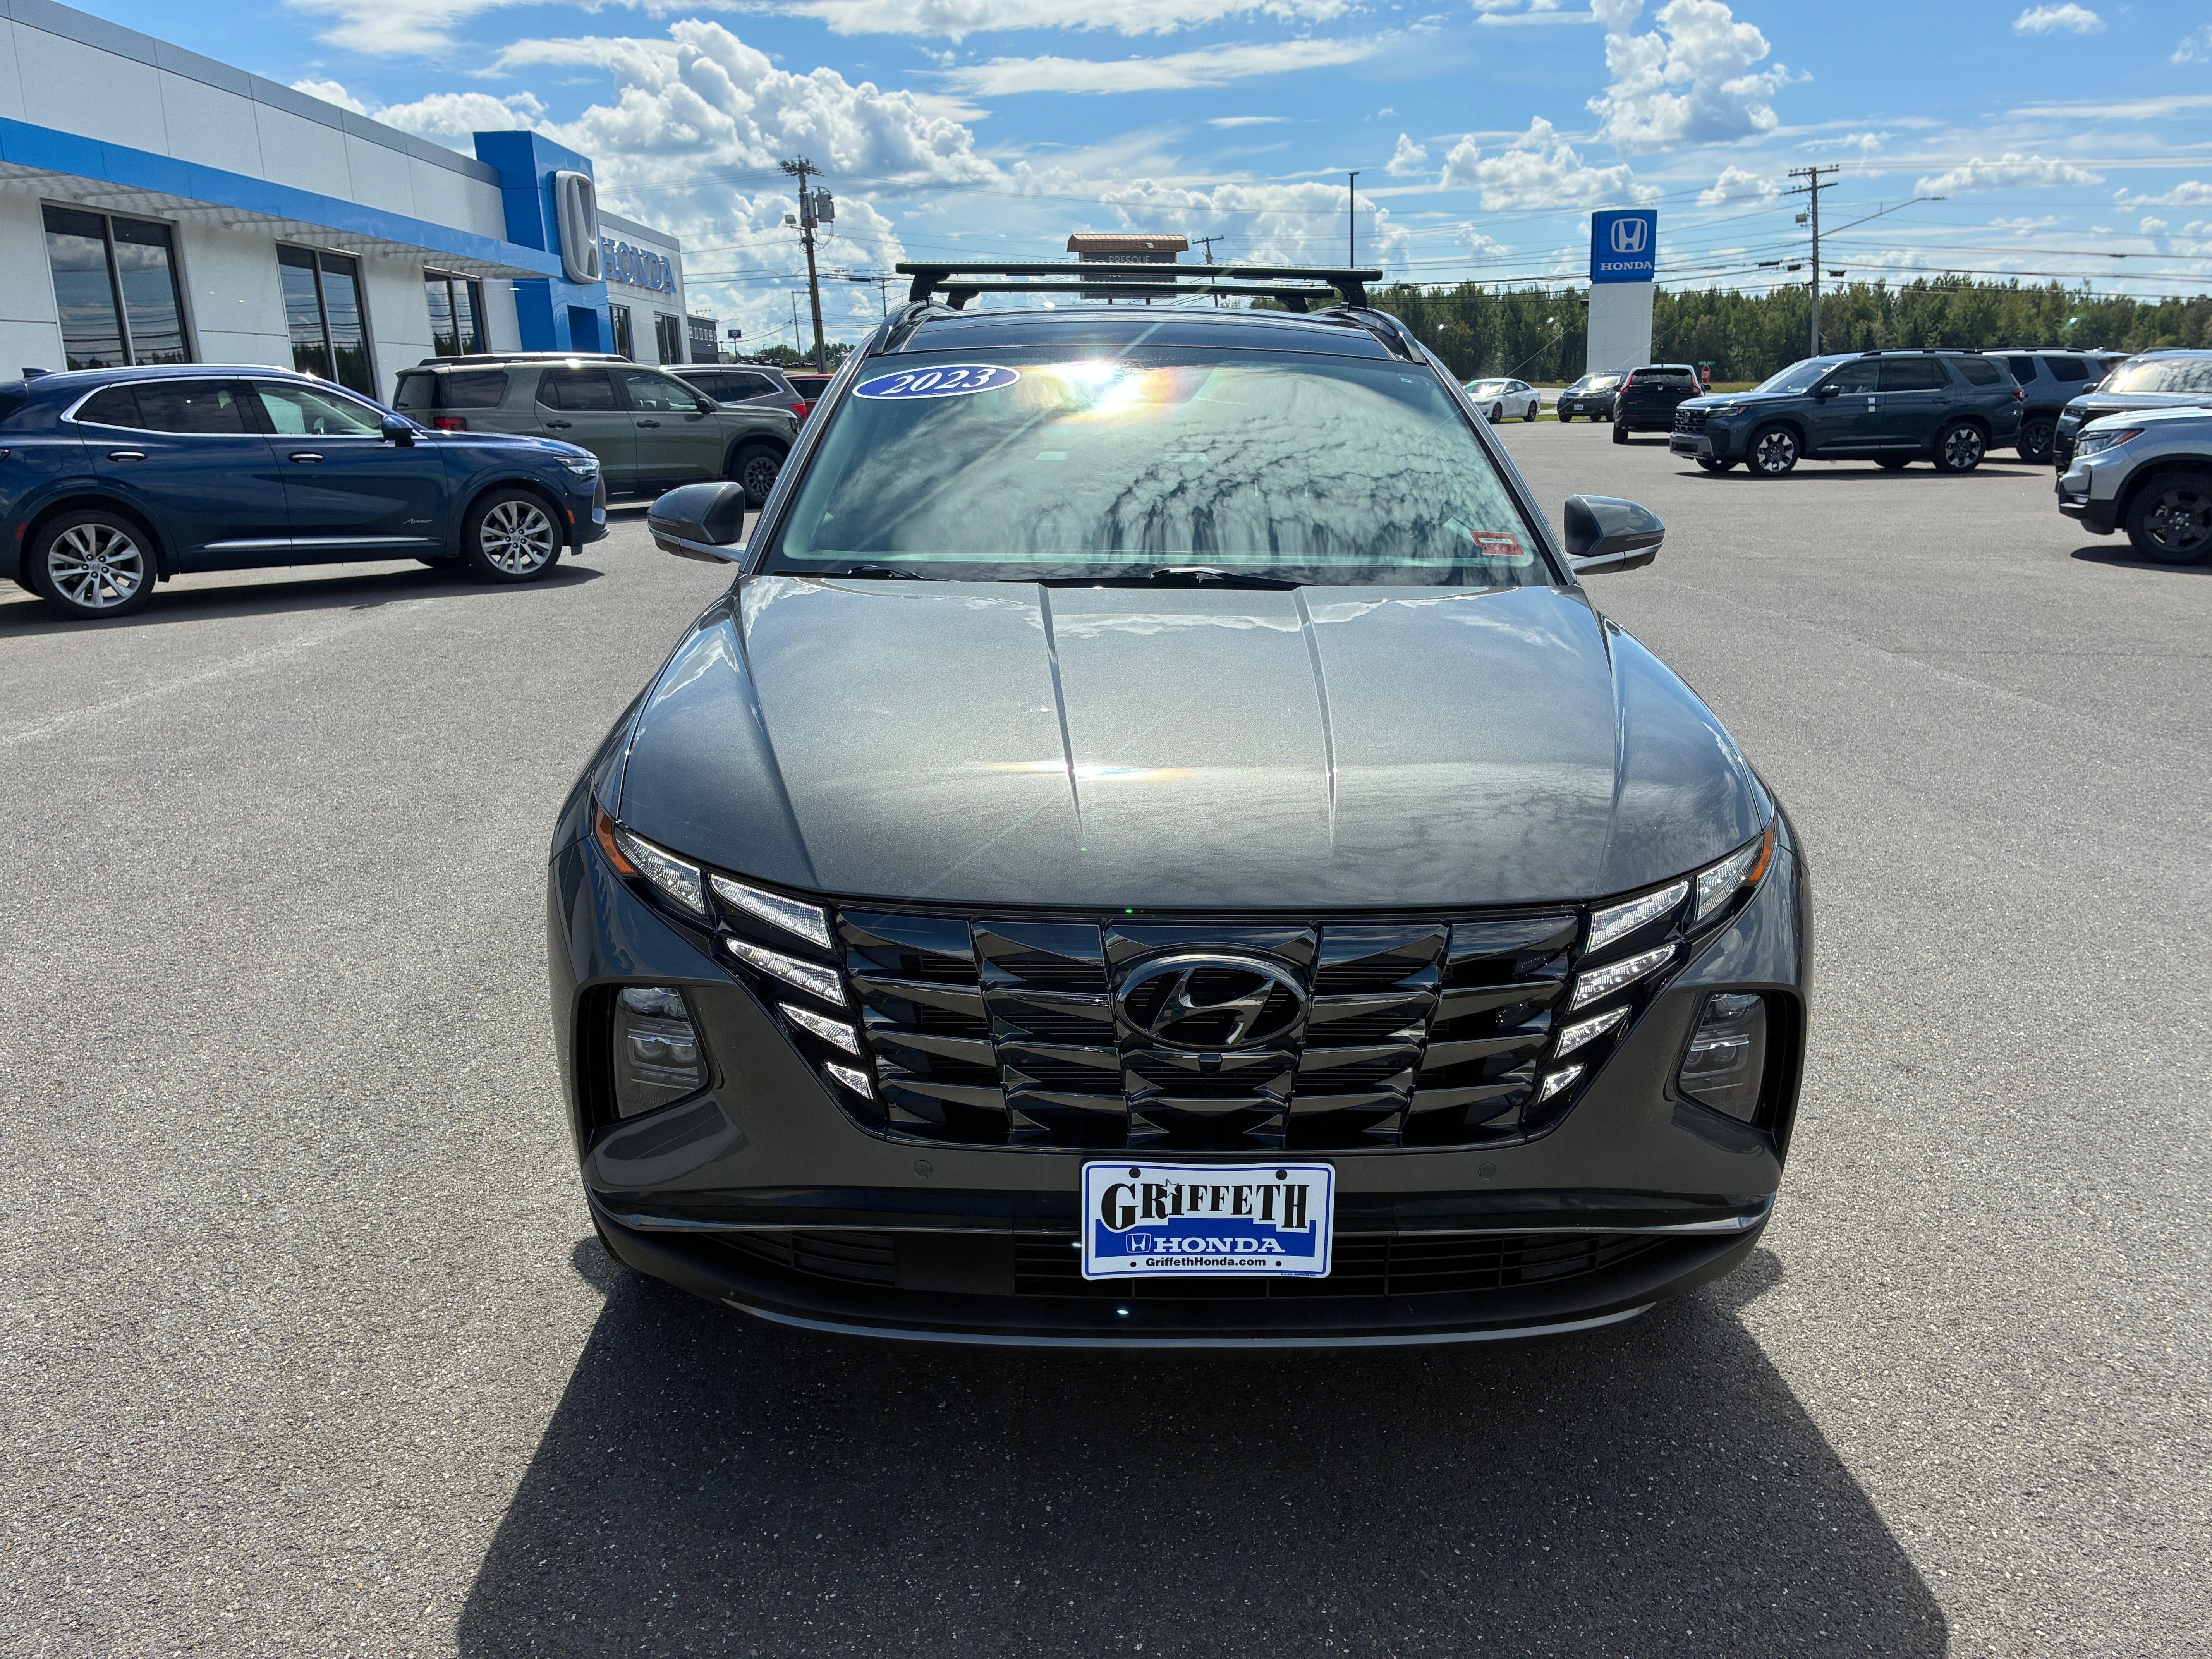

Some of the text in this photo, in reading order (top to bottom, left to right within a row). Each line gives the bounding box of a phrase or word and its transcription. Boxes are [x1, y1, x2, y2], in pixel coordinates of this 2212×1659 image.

[601, 236, 677, 293] HONDA
[1600, 261, 1652, 270] HONDA
[879, 369, 997, 395] 2023
[1101, 1183, 1309, 1230] GRIFFETH
[1153, 1238, 1285, 1253] HONDA
[1146, 1257, 1266, 1267] GriffethHonda.com
